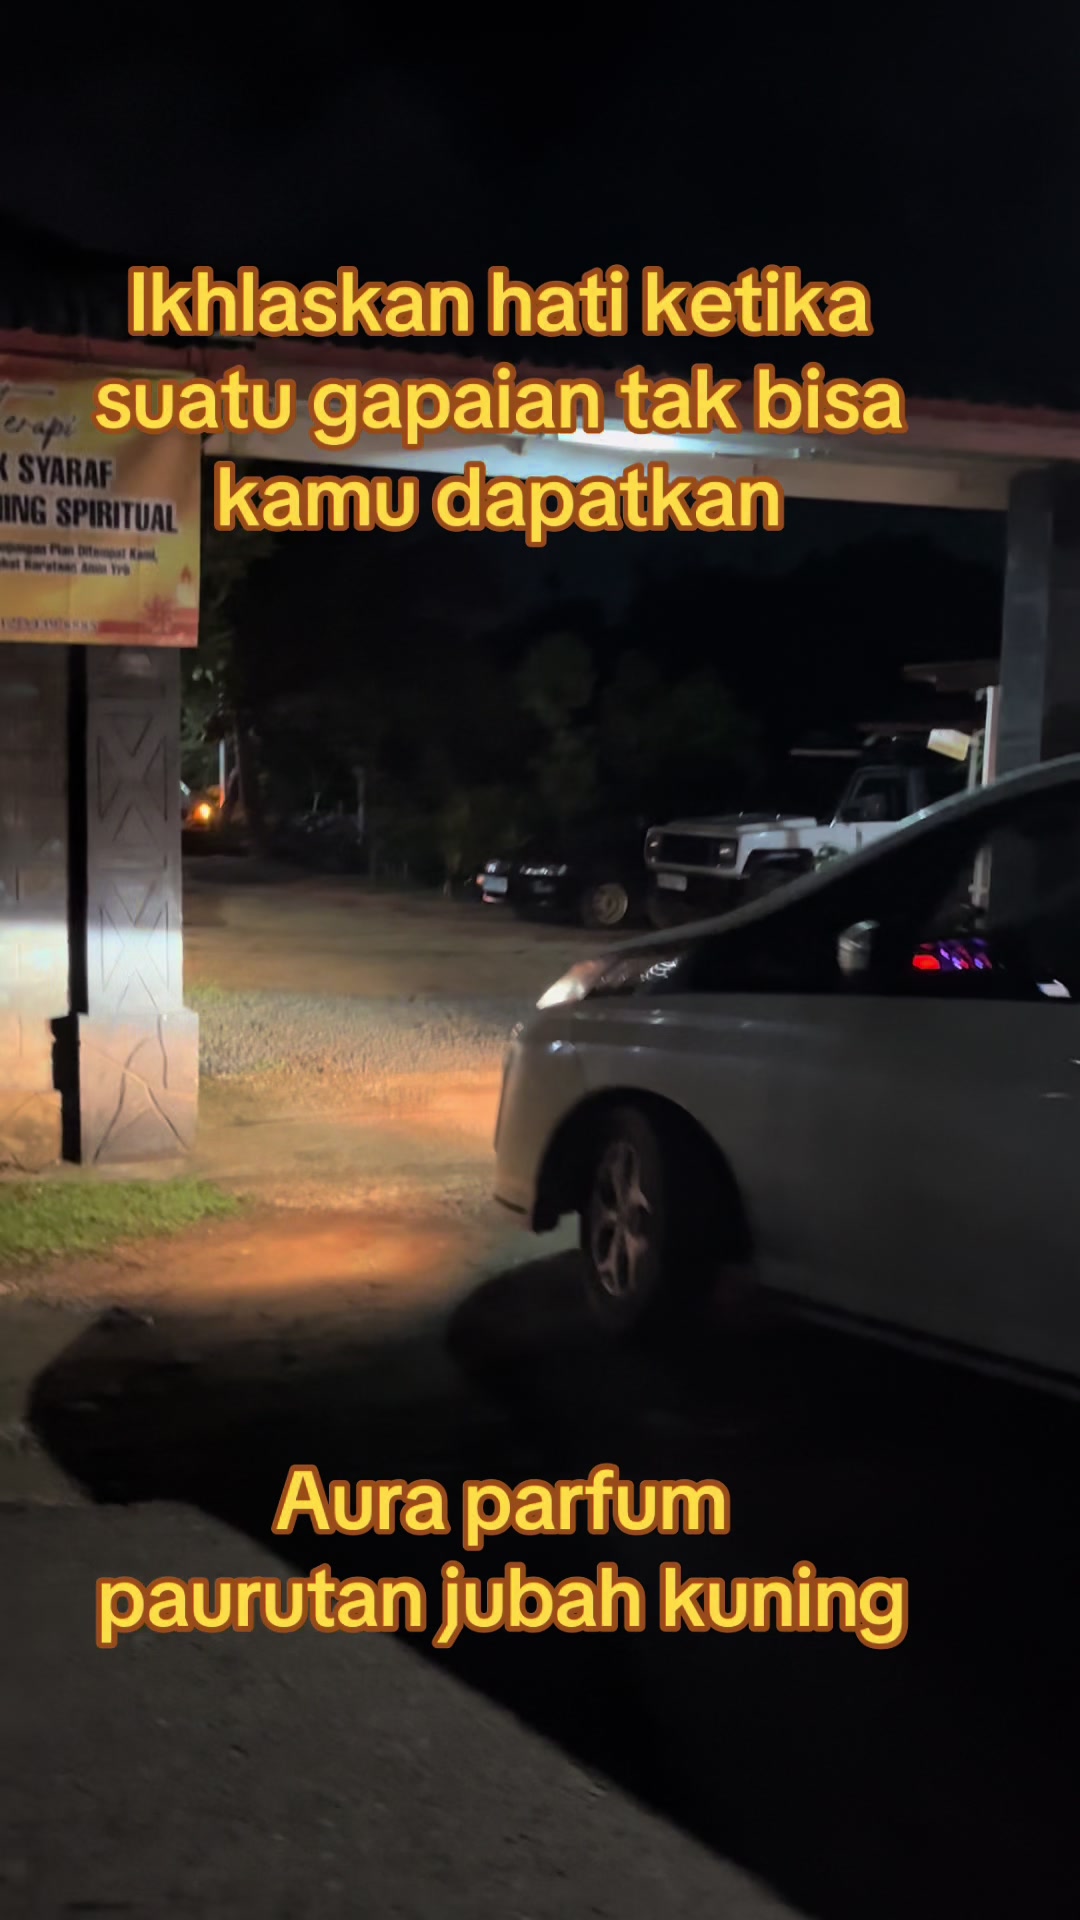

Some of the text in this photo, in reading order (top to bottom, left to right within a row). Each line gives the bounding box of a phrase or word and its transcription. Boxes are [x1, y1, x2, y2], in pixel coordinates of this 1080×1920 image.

[18, 453, 112, 488] SYARAF
[0, 494, 178, 533] ING SPIRITUAL
